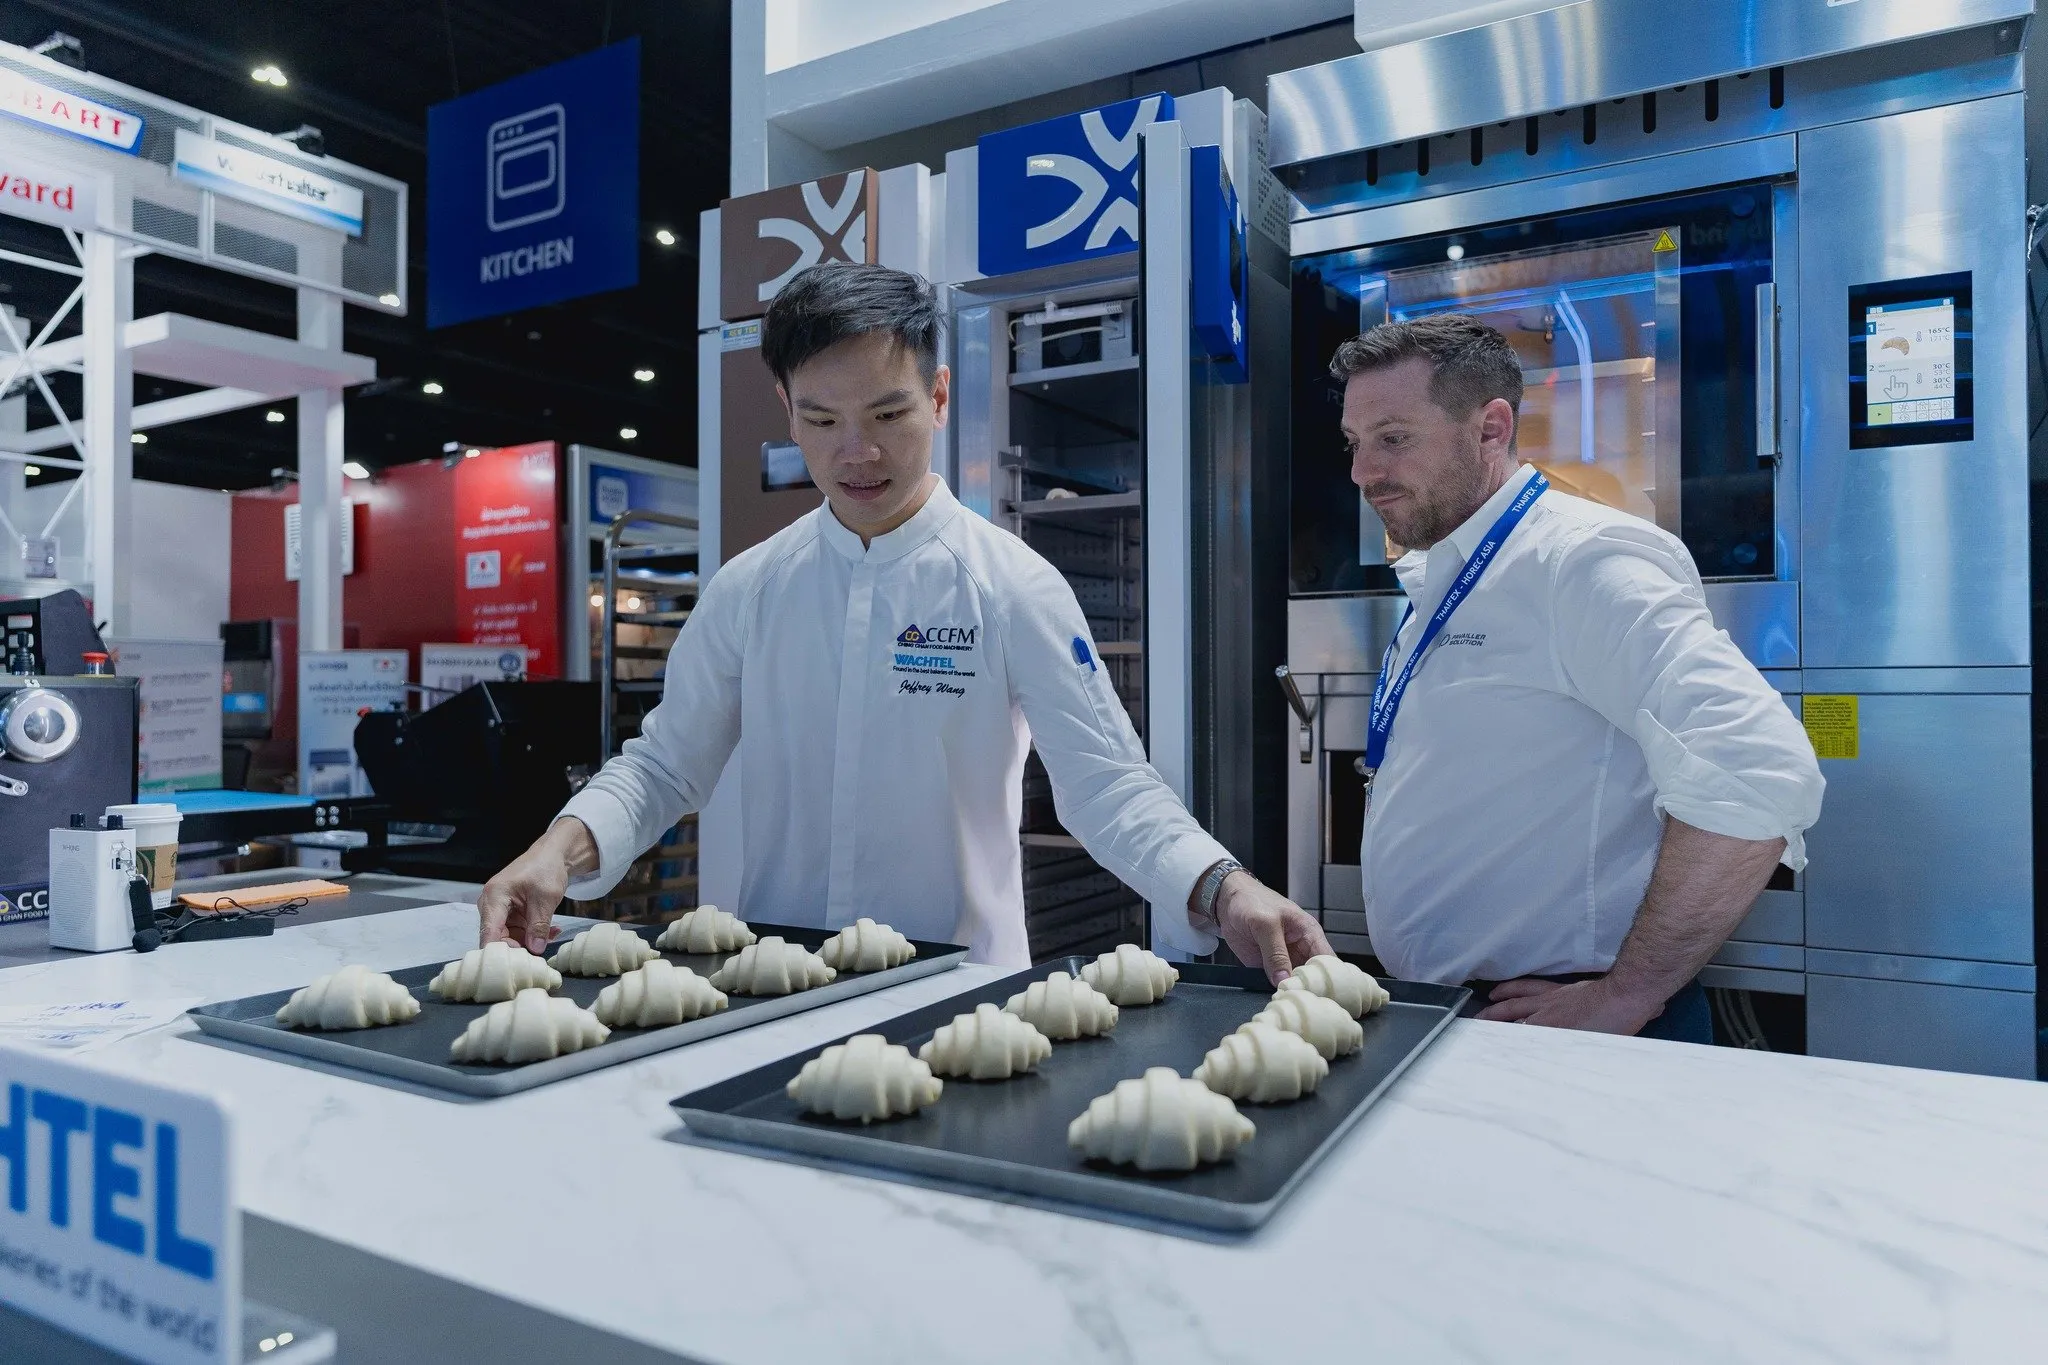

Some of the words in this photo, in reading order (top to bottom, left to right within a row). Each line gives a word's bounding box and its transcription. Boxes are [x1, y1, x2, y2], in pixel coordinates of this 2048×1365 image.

[480, 236, 574, 283] KITCHEN
[1511, 486, 1538, 512] THAIFEX
[1435, 589, 1462, 621] THAIFEX
[1461, 557, 1484, 585] HOREC
[1480, 540, 1496, 559] ASIA
[926, 627, 975, 644] CCFM
[894, 653, 956, 669] WACHTEL
[898, 679, 932, 695] Jeffrey
[935, 682, 966, 698] Wang
[1377, 701, 1394, 733] THAIFEX
[1393, 668, 1410, 695] HOREC
[23, 910, 44, 919] FOOD
